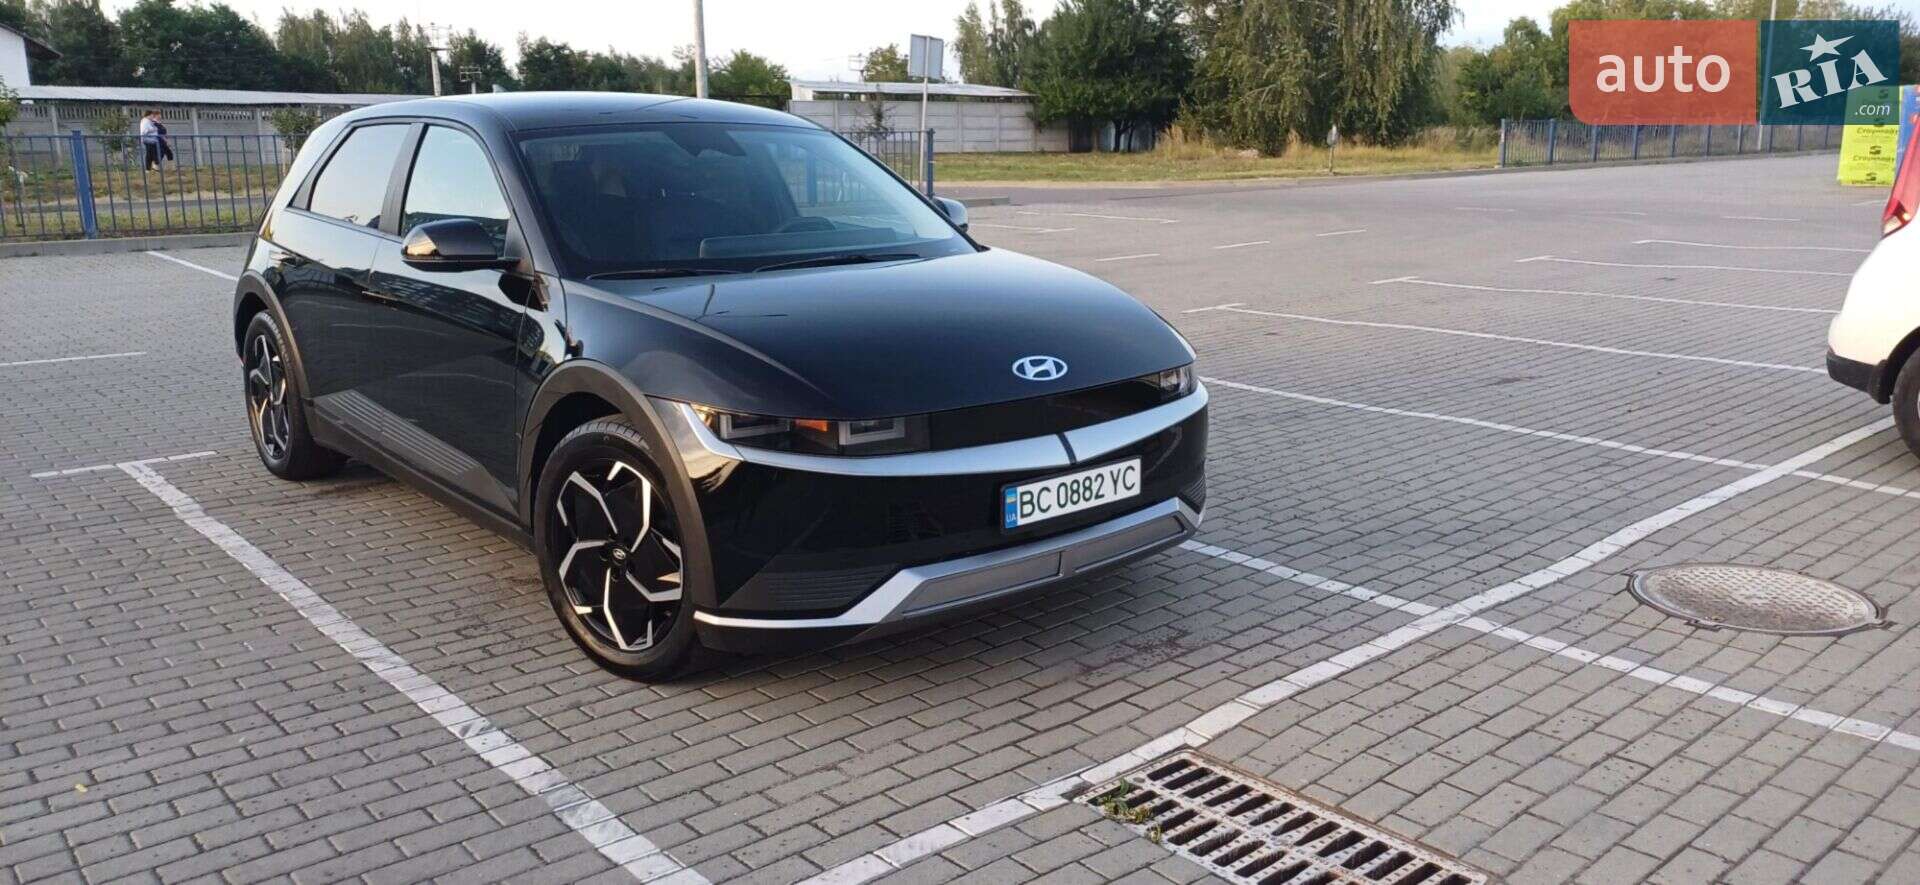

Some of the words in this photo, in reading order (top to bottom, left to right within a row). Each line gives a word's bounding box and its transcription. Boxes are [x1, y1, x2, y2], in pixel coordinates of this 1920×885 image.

[1020, 486, 1052, 519] BC
[1056, 472, 1105, 509] 0882
[1109, 465, 1136, 496] YC
[1006, 513, 1017, 523] UA
